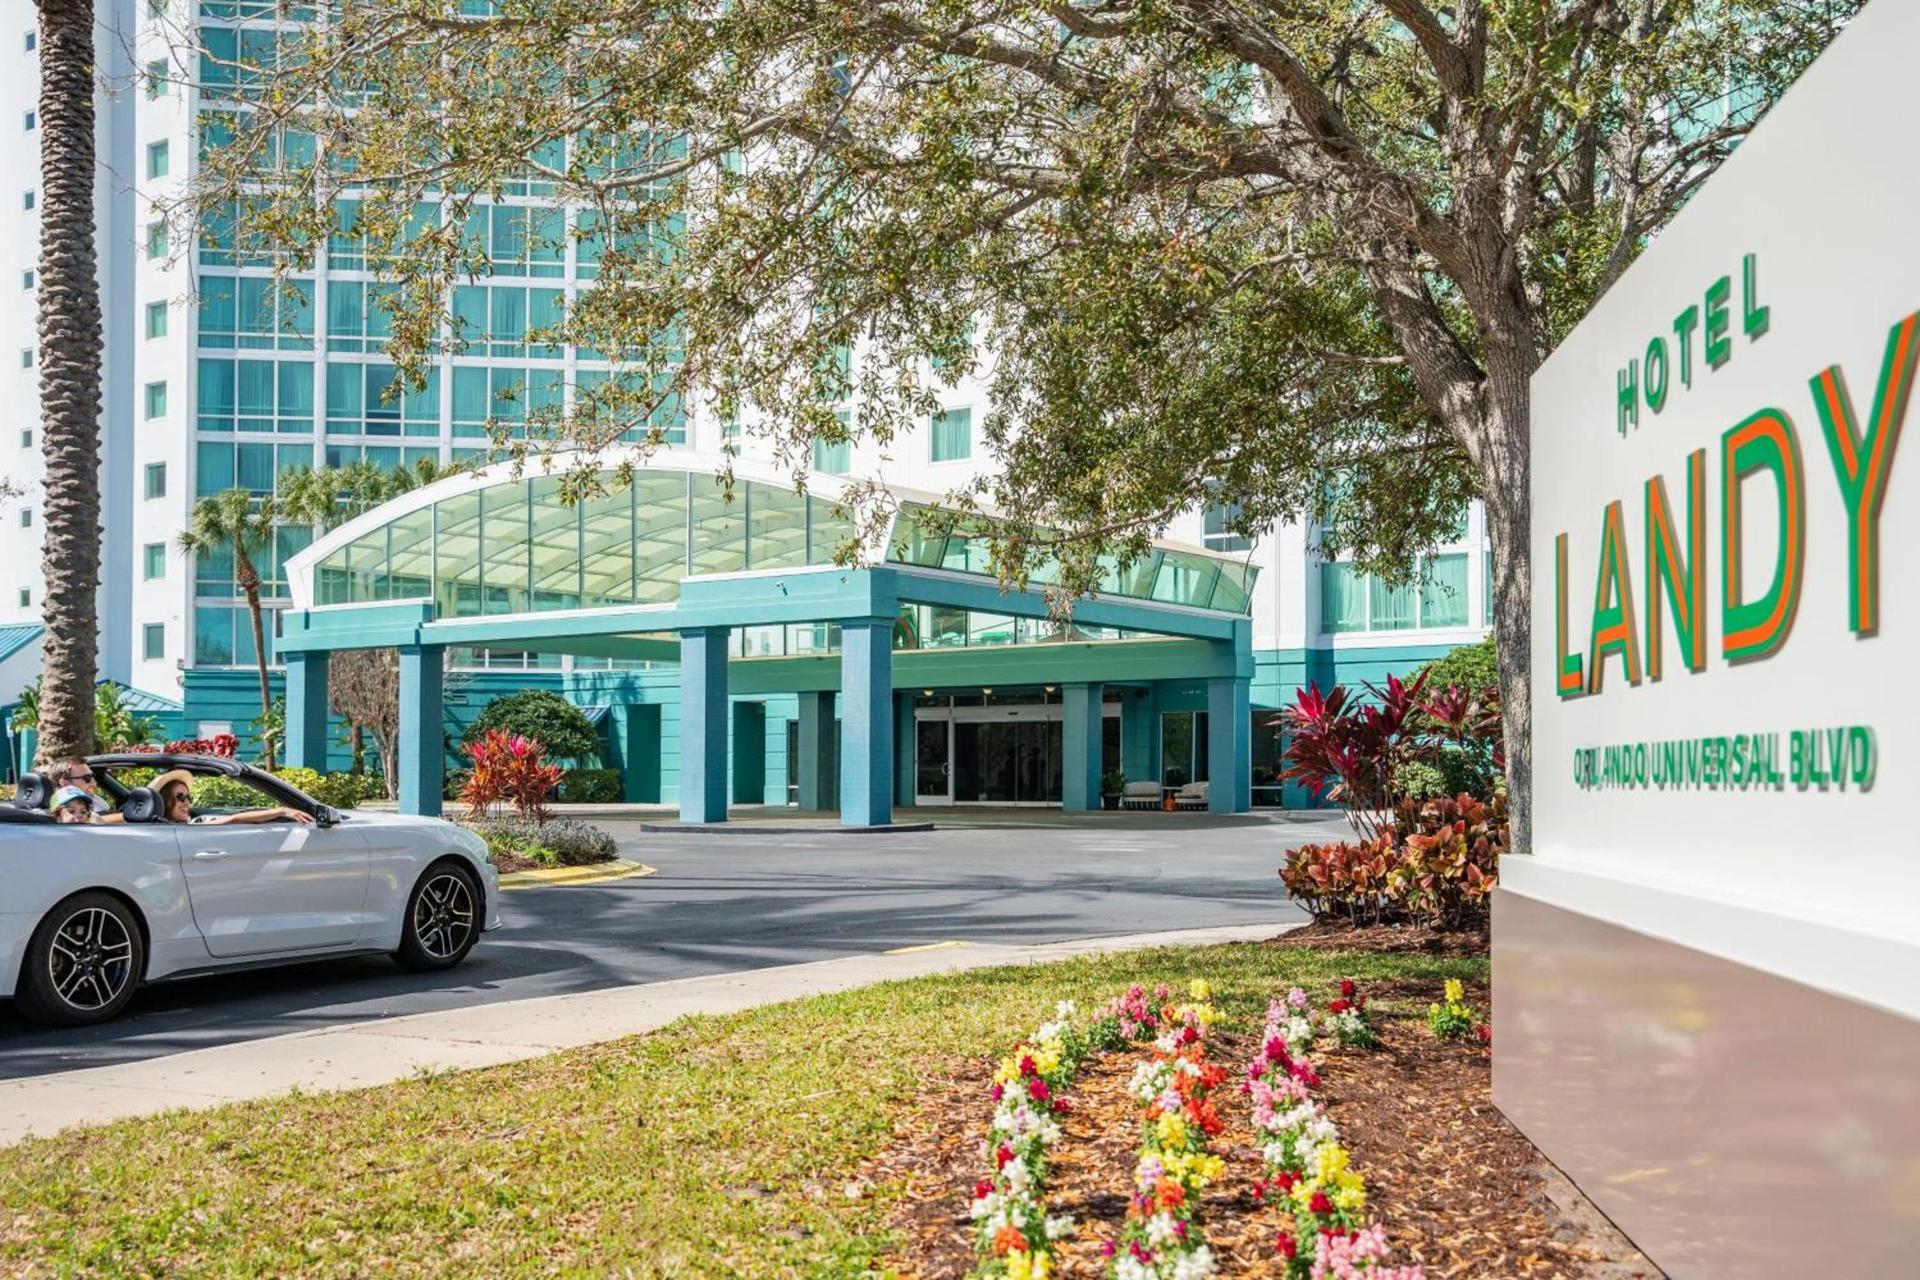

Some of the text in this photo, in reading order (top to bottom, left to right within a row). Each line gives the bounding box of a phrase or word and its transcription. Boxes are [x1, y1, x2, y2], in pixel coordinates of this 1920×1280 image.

[1617, 253, 1770, 437] HOTEL
[1556, 309, 1920, 699] LANDY
[1574, 726, 1876, 792] ORLANDO UNIVERSAL BLVD
